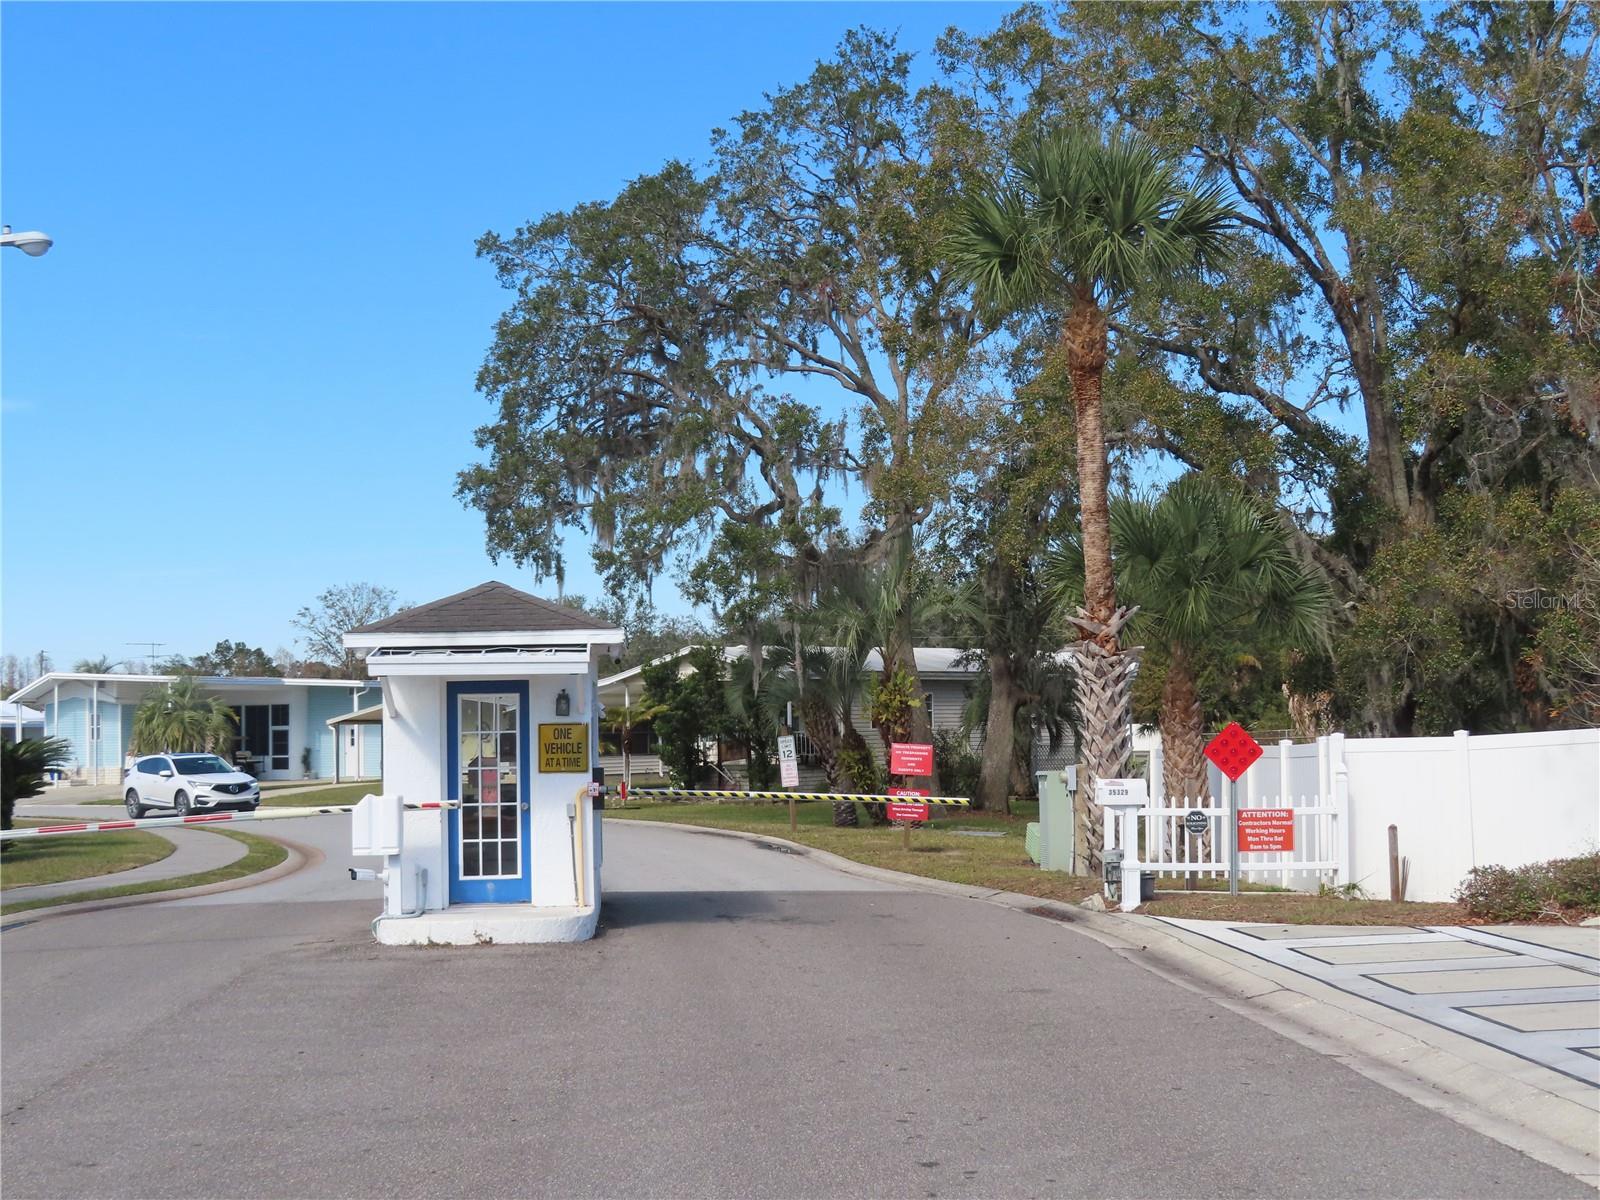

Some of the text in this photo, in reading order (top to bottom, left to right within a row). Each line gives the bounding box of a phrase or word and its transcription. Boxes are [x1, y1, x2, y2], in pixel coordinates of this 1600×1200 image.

[553, 728, 572, 740] ONE
[544, 743, 582, 754] VEHICLE
[783, 750, 792, 758] 12
[545, 758, 580, 768] AT A TIME
